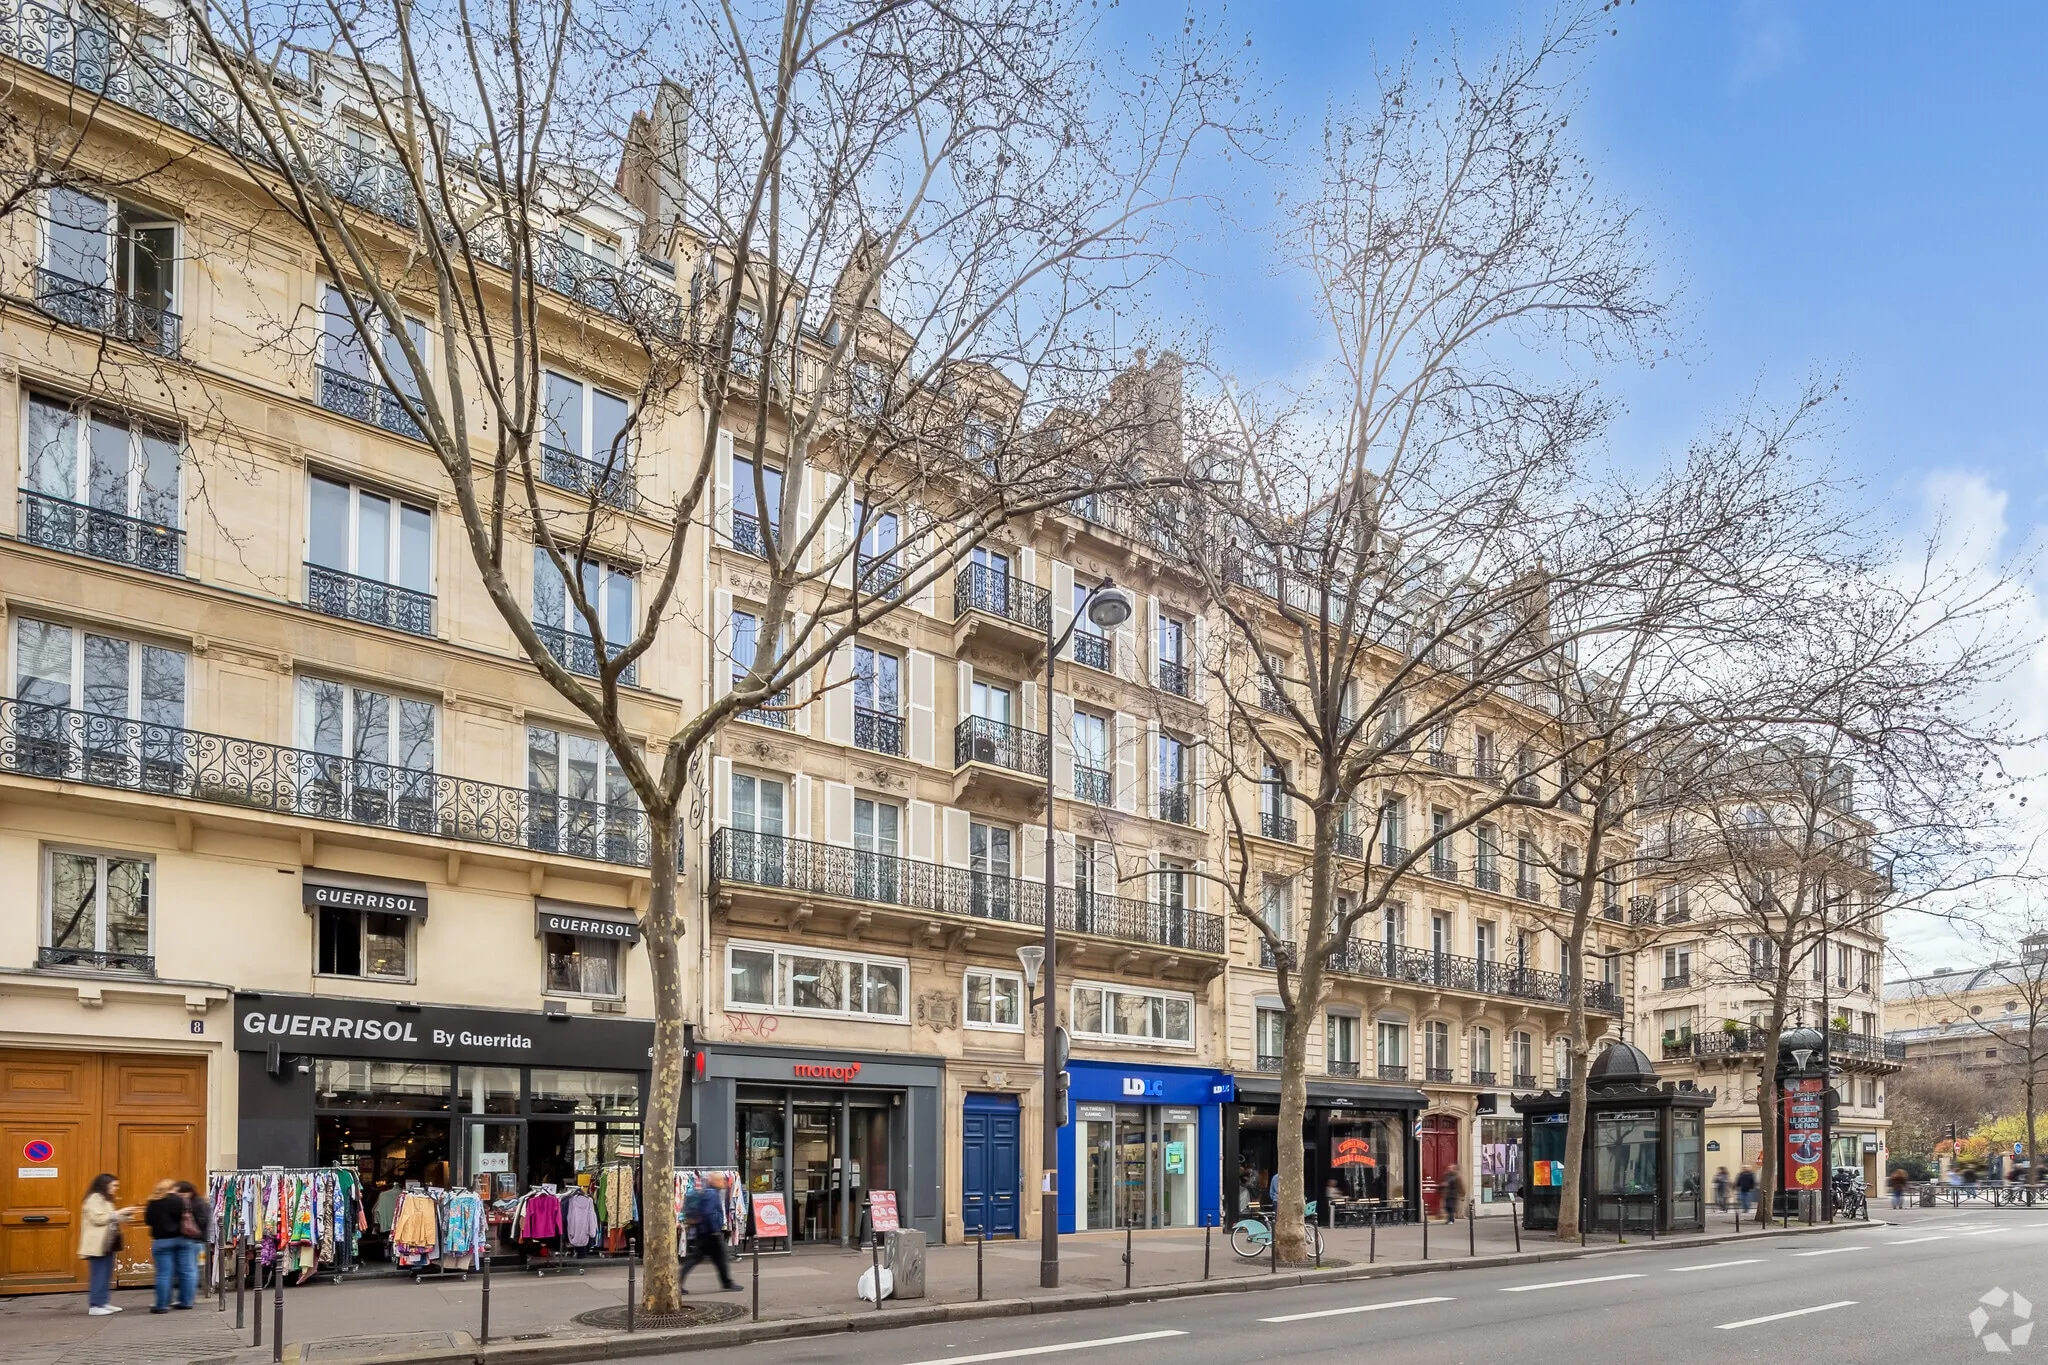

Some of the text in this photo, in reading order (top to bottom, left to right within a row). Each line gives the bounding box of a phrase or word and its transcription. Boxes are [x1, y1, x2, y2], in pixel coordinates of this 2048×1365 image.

[316, 889, 417, 912] GUERRISOL
[549, 917, 632, 937] GUERRISOL
[193, 1021, 201, 1034] 8
[243, 1012, 532, 1049] GUERRISOL By Guerrida
[1123, 1078, 1163, 1096] LDLC
[1213, 1085, 1230, 1094] LDLC
